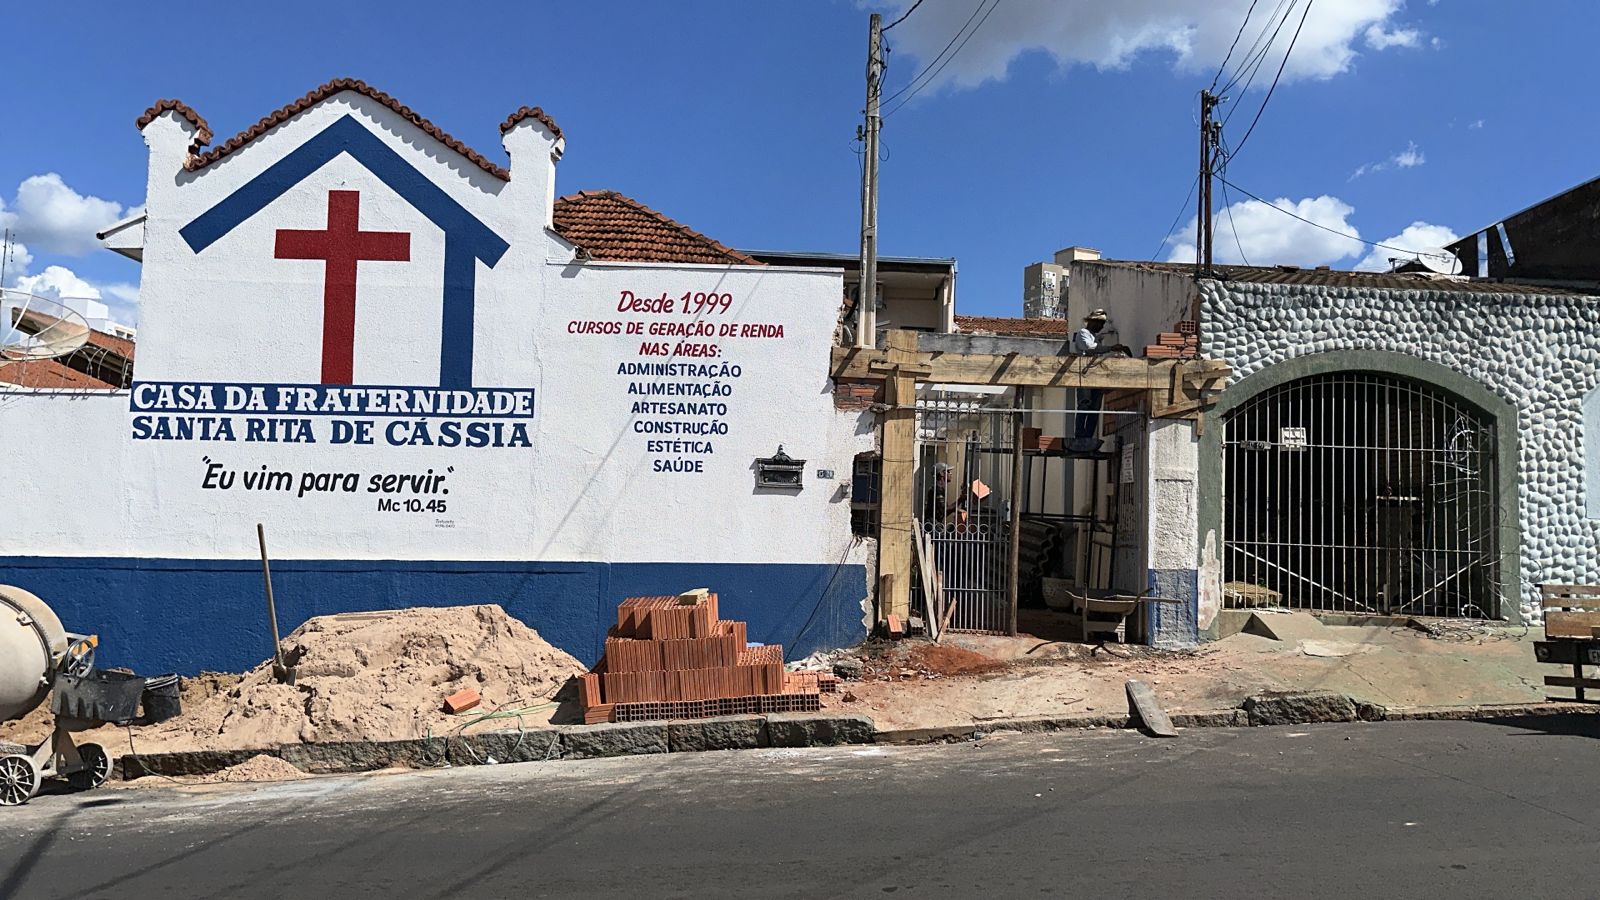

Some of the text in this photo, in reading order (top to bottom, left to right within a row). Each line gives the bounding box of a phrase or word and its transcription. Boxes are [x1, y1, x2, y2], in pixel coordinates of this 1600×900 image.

[617, 290, 674, 314] Desde
[568, 320, 784, 338] CURSOS DE GERAÇÃO DE RENDA
[639, 340, 722, 358] NAS ÁREAS:
[617, 362, 742, 378] ADMINISTRAÇÃO
[628, 381, 732, 398] ALIMENTAÇÃO
[132, 382, 533, 415] CASA DA FRATERNIDADE
[631, 402, 727, 416] ARTESANATO
[133, 415, 533, 447] SANTA RITA DE CÁSSIA
[634, 420, 729, 436] CONSTRUÇÃO
[648, 438, 713, 454] ESTÉTICA
[654, 457, 703, 473] SAÚDE
[244, 465, 292, 491] vim
[298, 472, 360, 498] para
[378, 498, 447, 513] Mc 10.45
